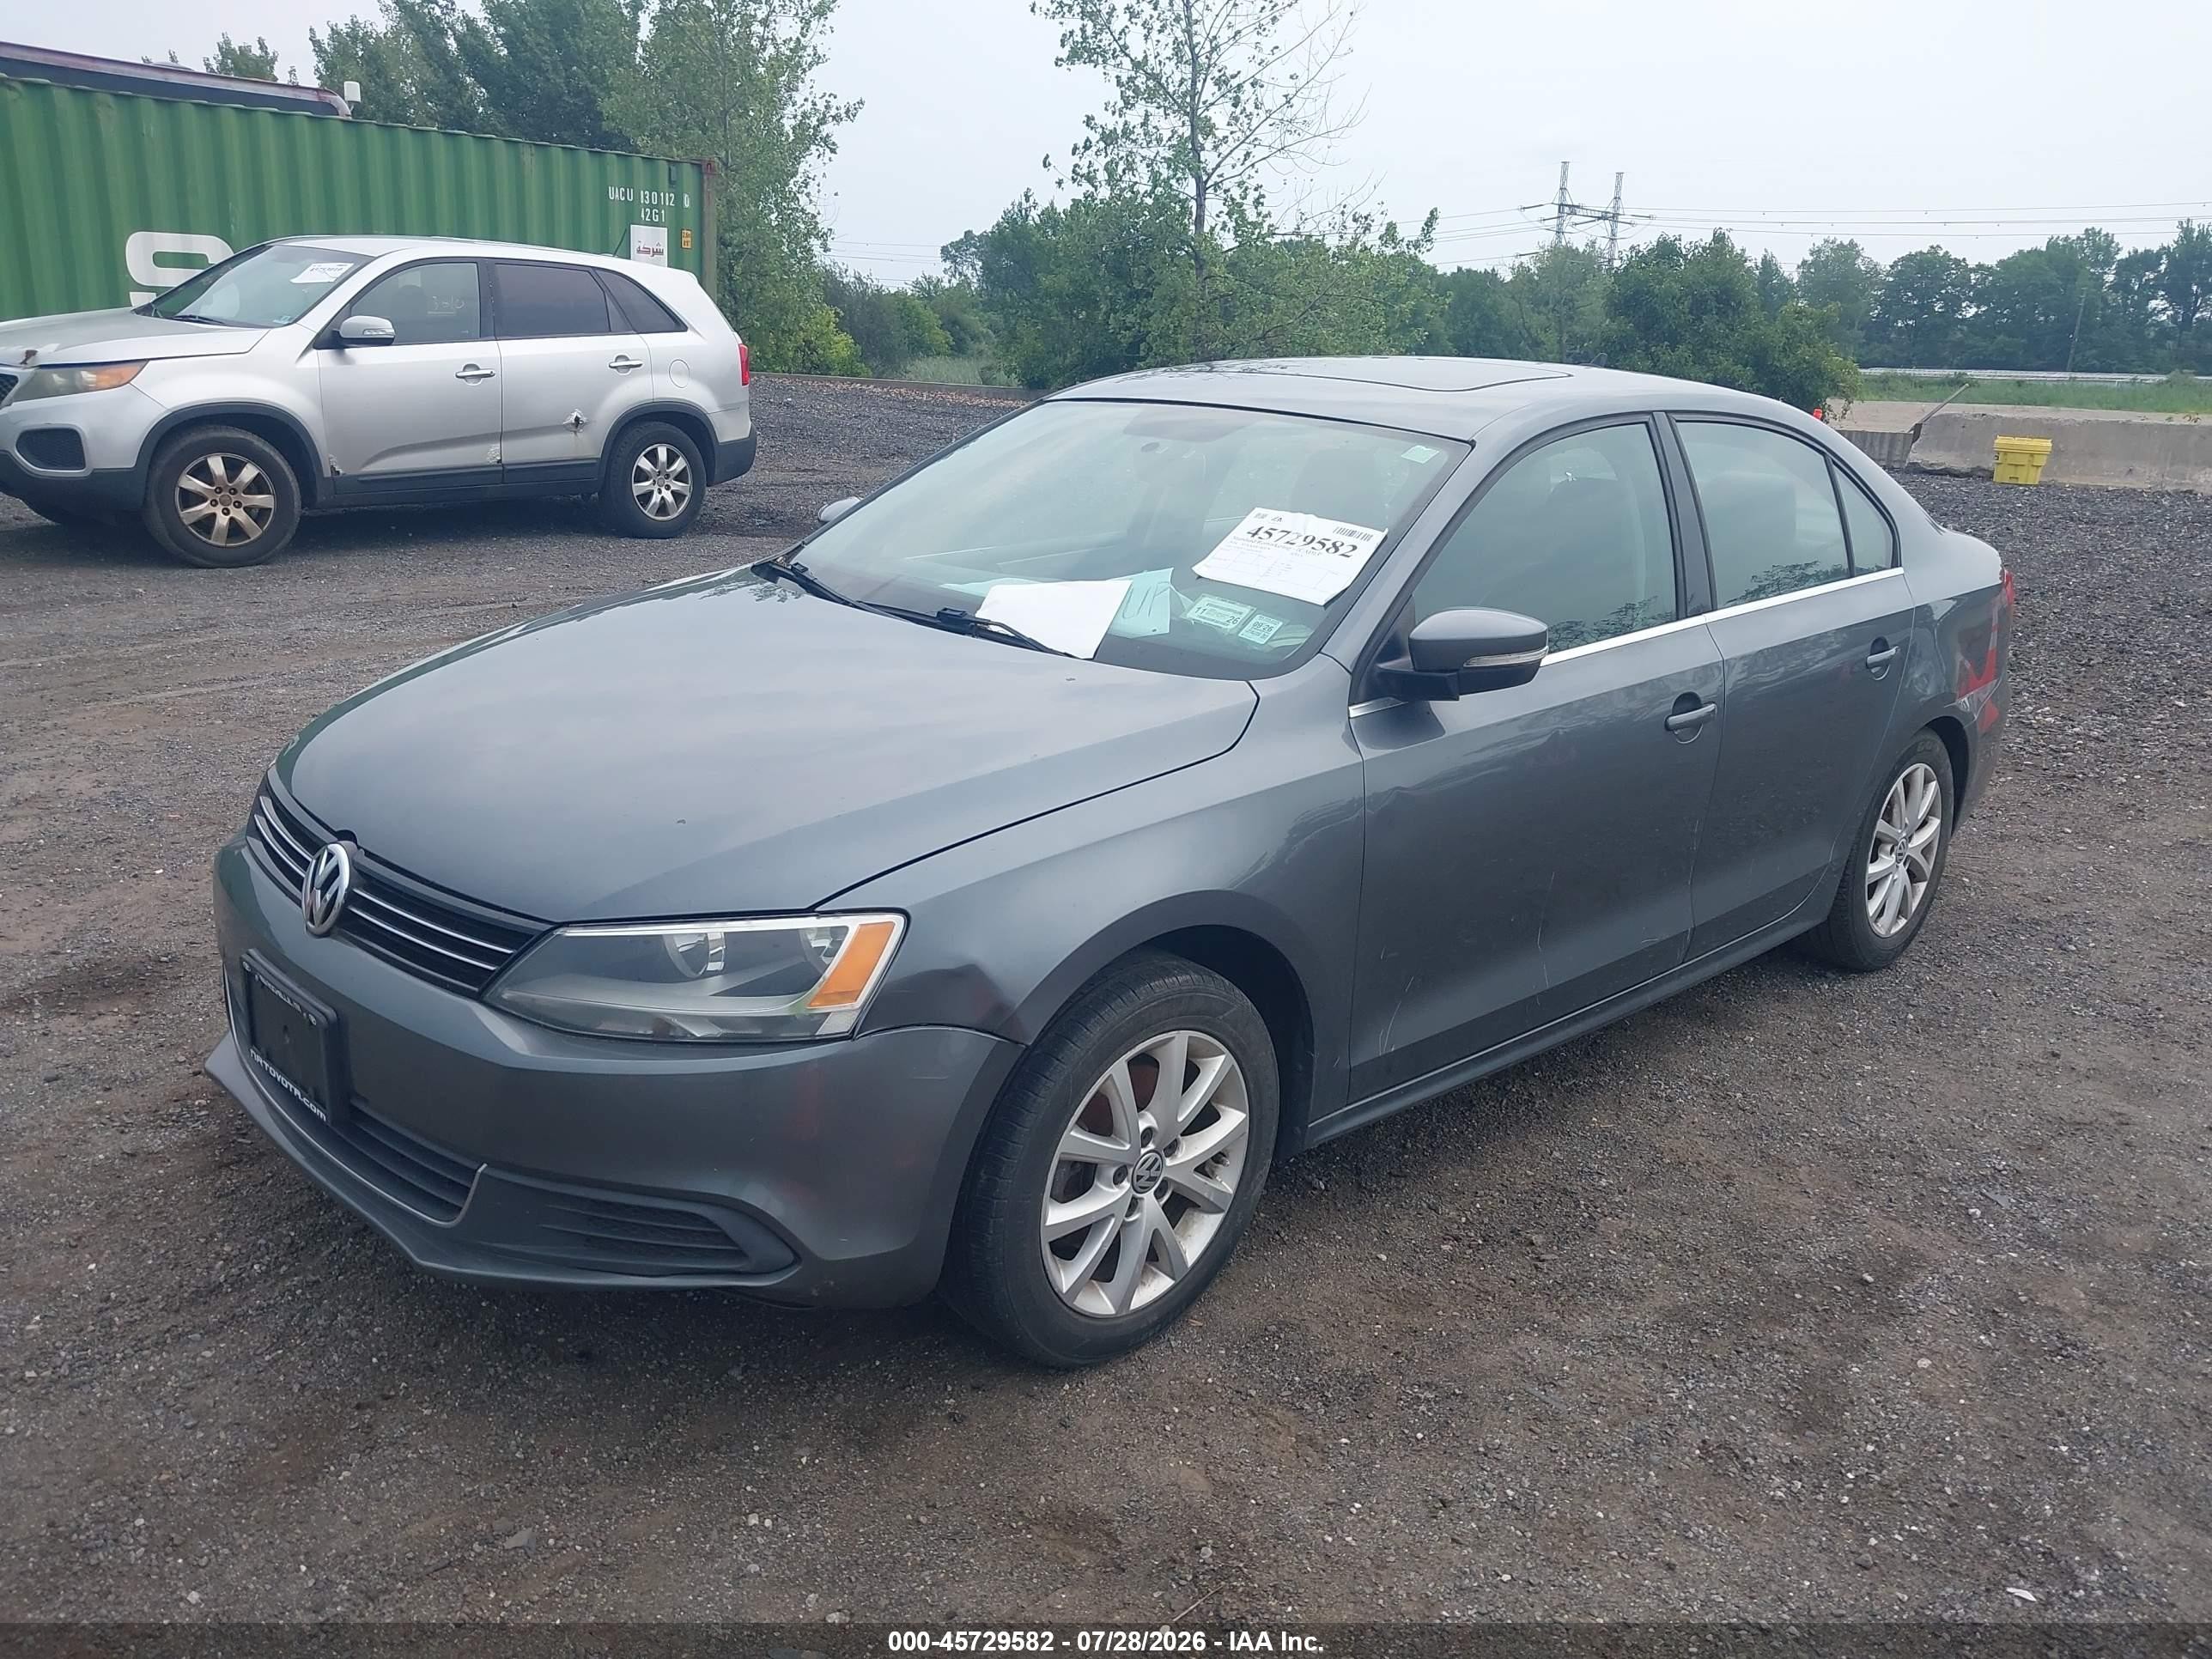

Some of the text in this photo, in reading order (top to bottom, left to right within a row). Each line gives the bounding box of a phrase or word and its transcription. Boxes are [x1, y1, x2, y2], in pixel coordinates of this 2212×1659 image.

[608, 185, 634, 202] UACU
[641, 208, 665, 222] 42G1
[1246, 526, 1358, 559] 45729582
[1225, 615, 1240, 625] 26
